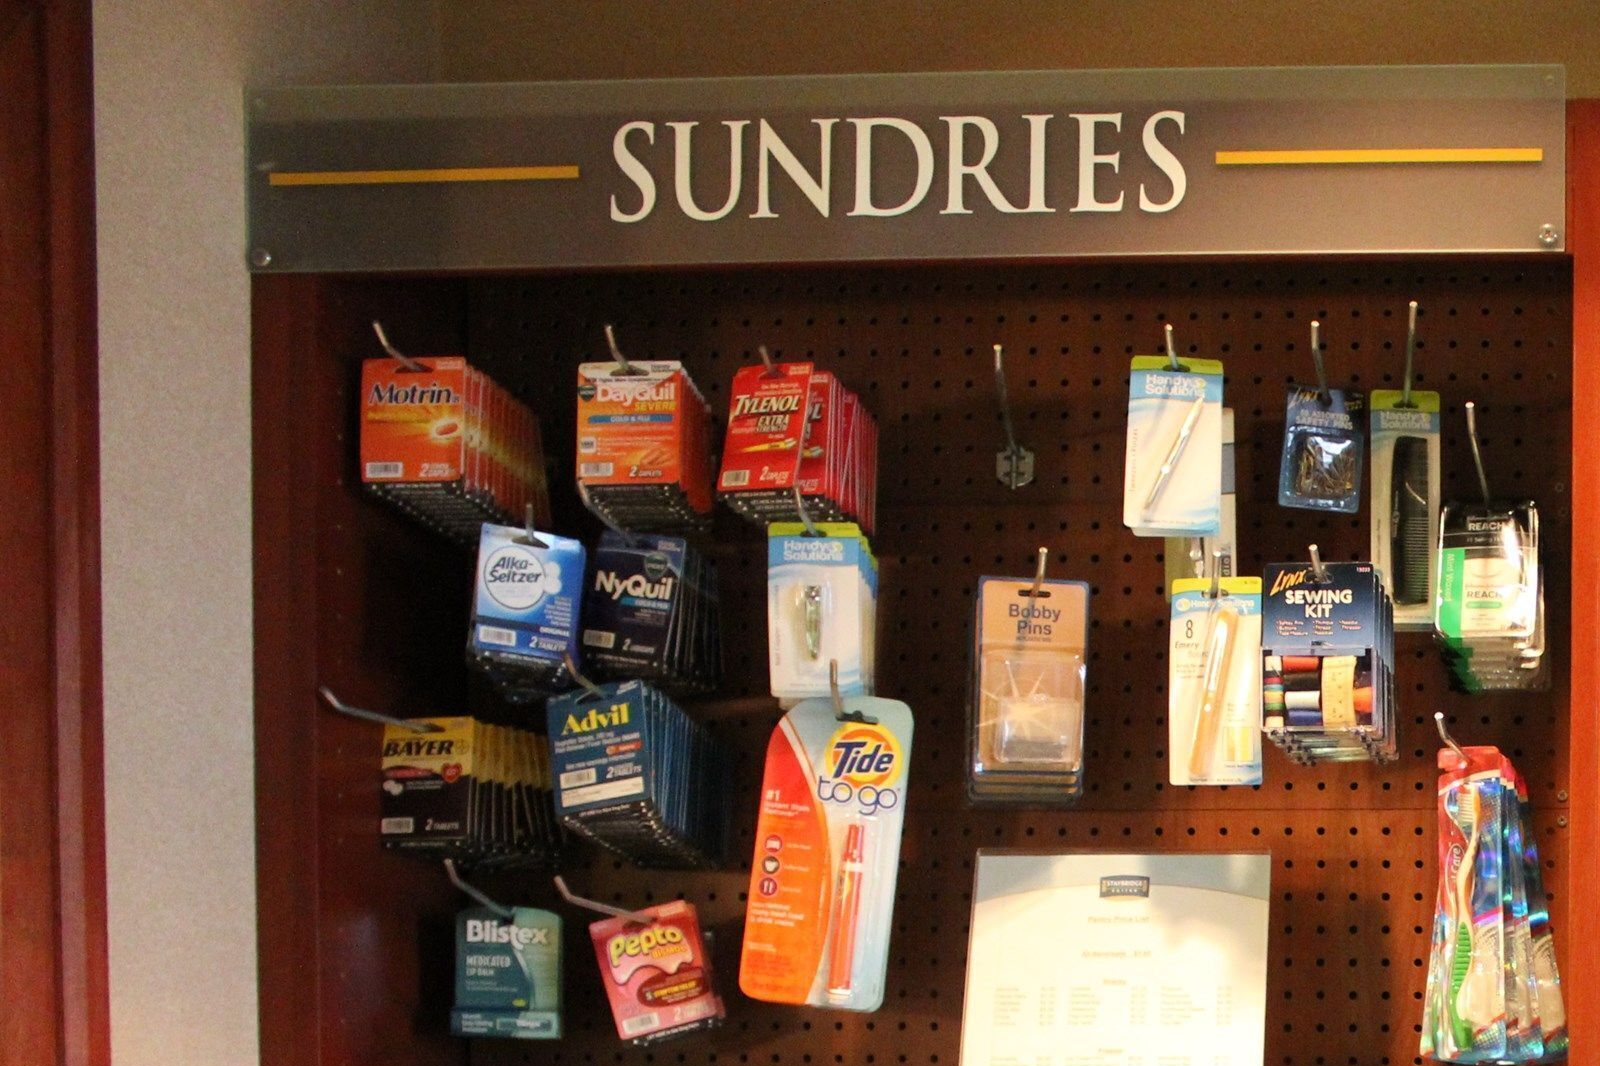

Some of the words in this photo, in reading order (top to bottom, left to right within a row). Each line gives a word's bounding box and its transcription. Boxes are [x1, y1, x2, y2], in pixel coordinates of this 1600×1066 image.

[609, 109, 1188, 224] SUNDRIES
[369, 383, 451, 405] Motrin
[596, 383, 676, 407] DayQuil
[1145, 384, 1206, 398] Solutions
[734, 394, 801, 417] TYLENOL
[757, 414, 789, 428] EXTRA
[1468, 521, 1504, 531] REACH
[496, 556, 534, 570] Alka-
[784, 551, 843, 562] Solutions
[487, 568, 542, 584] Seltzer
[595, 570, 674, 600] NyQuil
[1270, 570, 1306, 596] LYNX
[1285, 590, 1353, 605] SEWING
[1467, 590, 1502, 599] REACH
[1009, 603, 1061, 622] Bobby
[1305, 604, 1333, 618] KIT
[1017, 621, 1052, 636] Pins
[1185, 620, 1194, 639] 8
[561, 703, 630, 735] Advil
[384, 739, 455, 757] BAYER
[833, 741, 894, 779] Tide
[818, 775, 852, 803] to
[858, 786, 898, 816] go
[1106, 879, 1143, 888] STAYBRIDGE
[466, 919, 548, 949] Blistex
[609, 926, 684, 967] Pepto
[466, 955, 511, 968] MEDICATED
